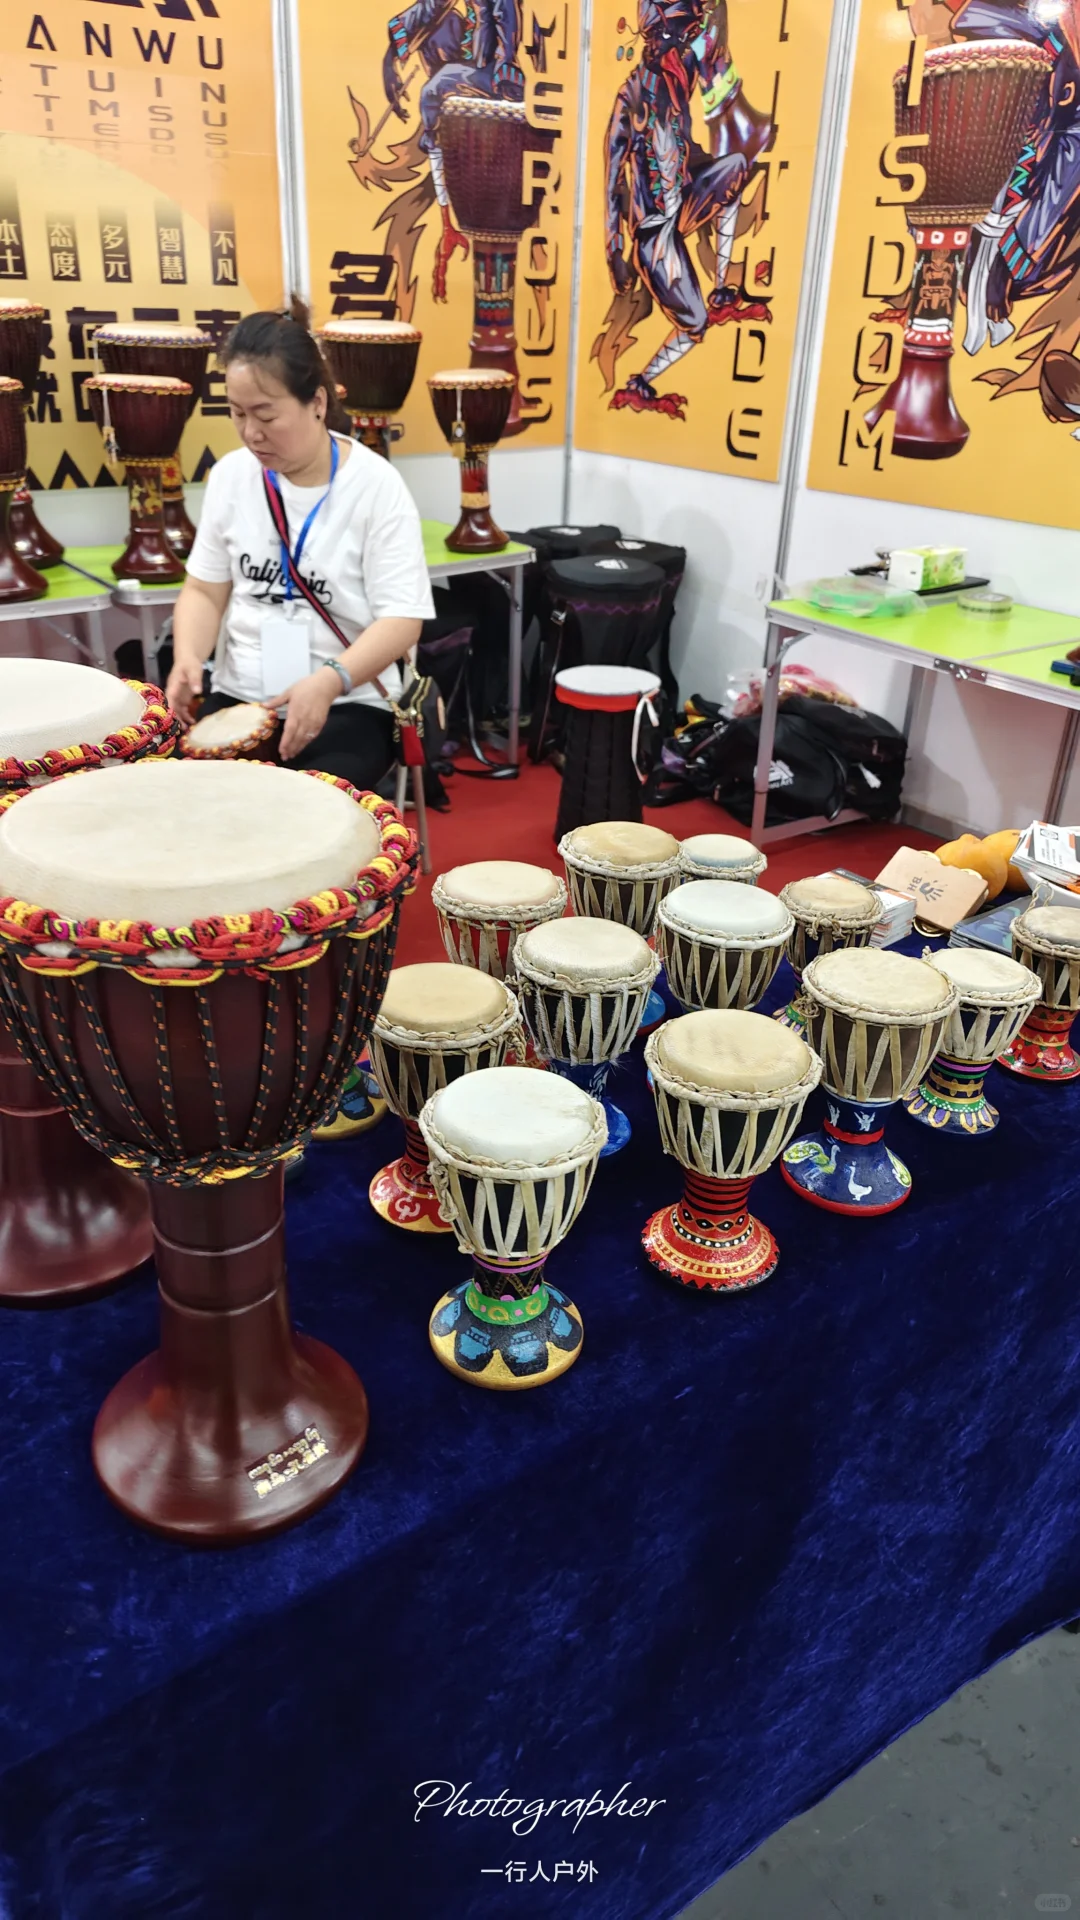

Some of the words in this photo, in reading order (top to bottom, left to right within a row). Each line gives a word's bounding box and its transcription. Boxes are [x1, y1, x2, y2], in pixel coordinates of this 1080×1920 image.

[0, 219, 24, 275] 本土
[48, 222, 77, 278] 态度
[102, 224, 129, 279] 多元
[159, 227, 184, 280] 智慧
[213, 230, 236, 282] 不凡
